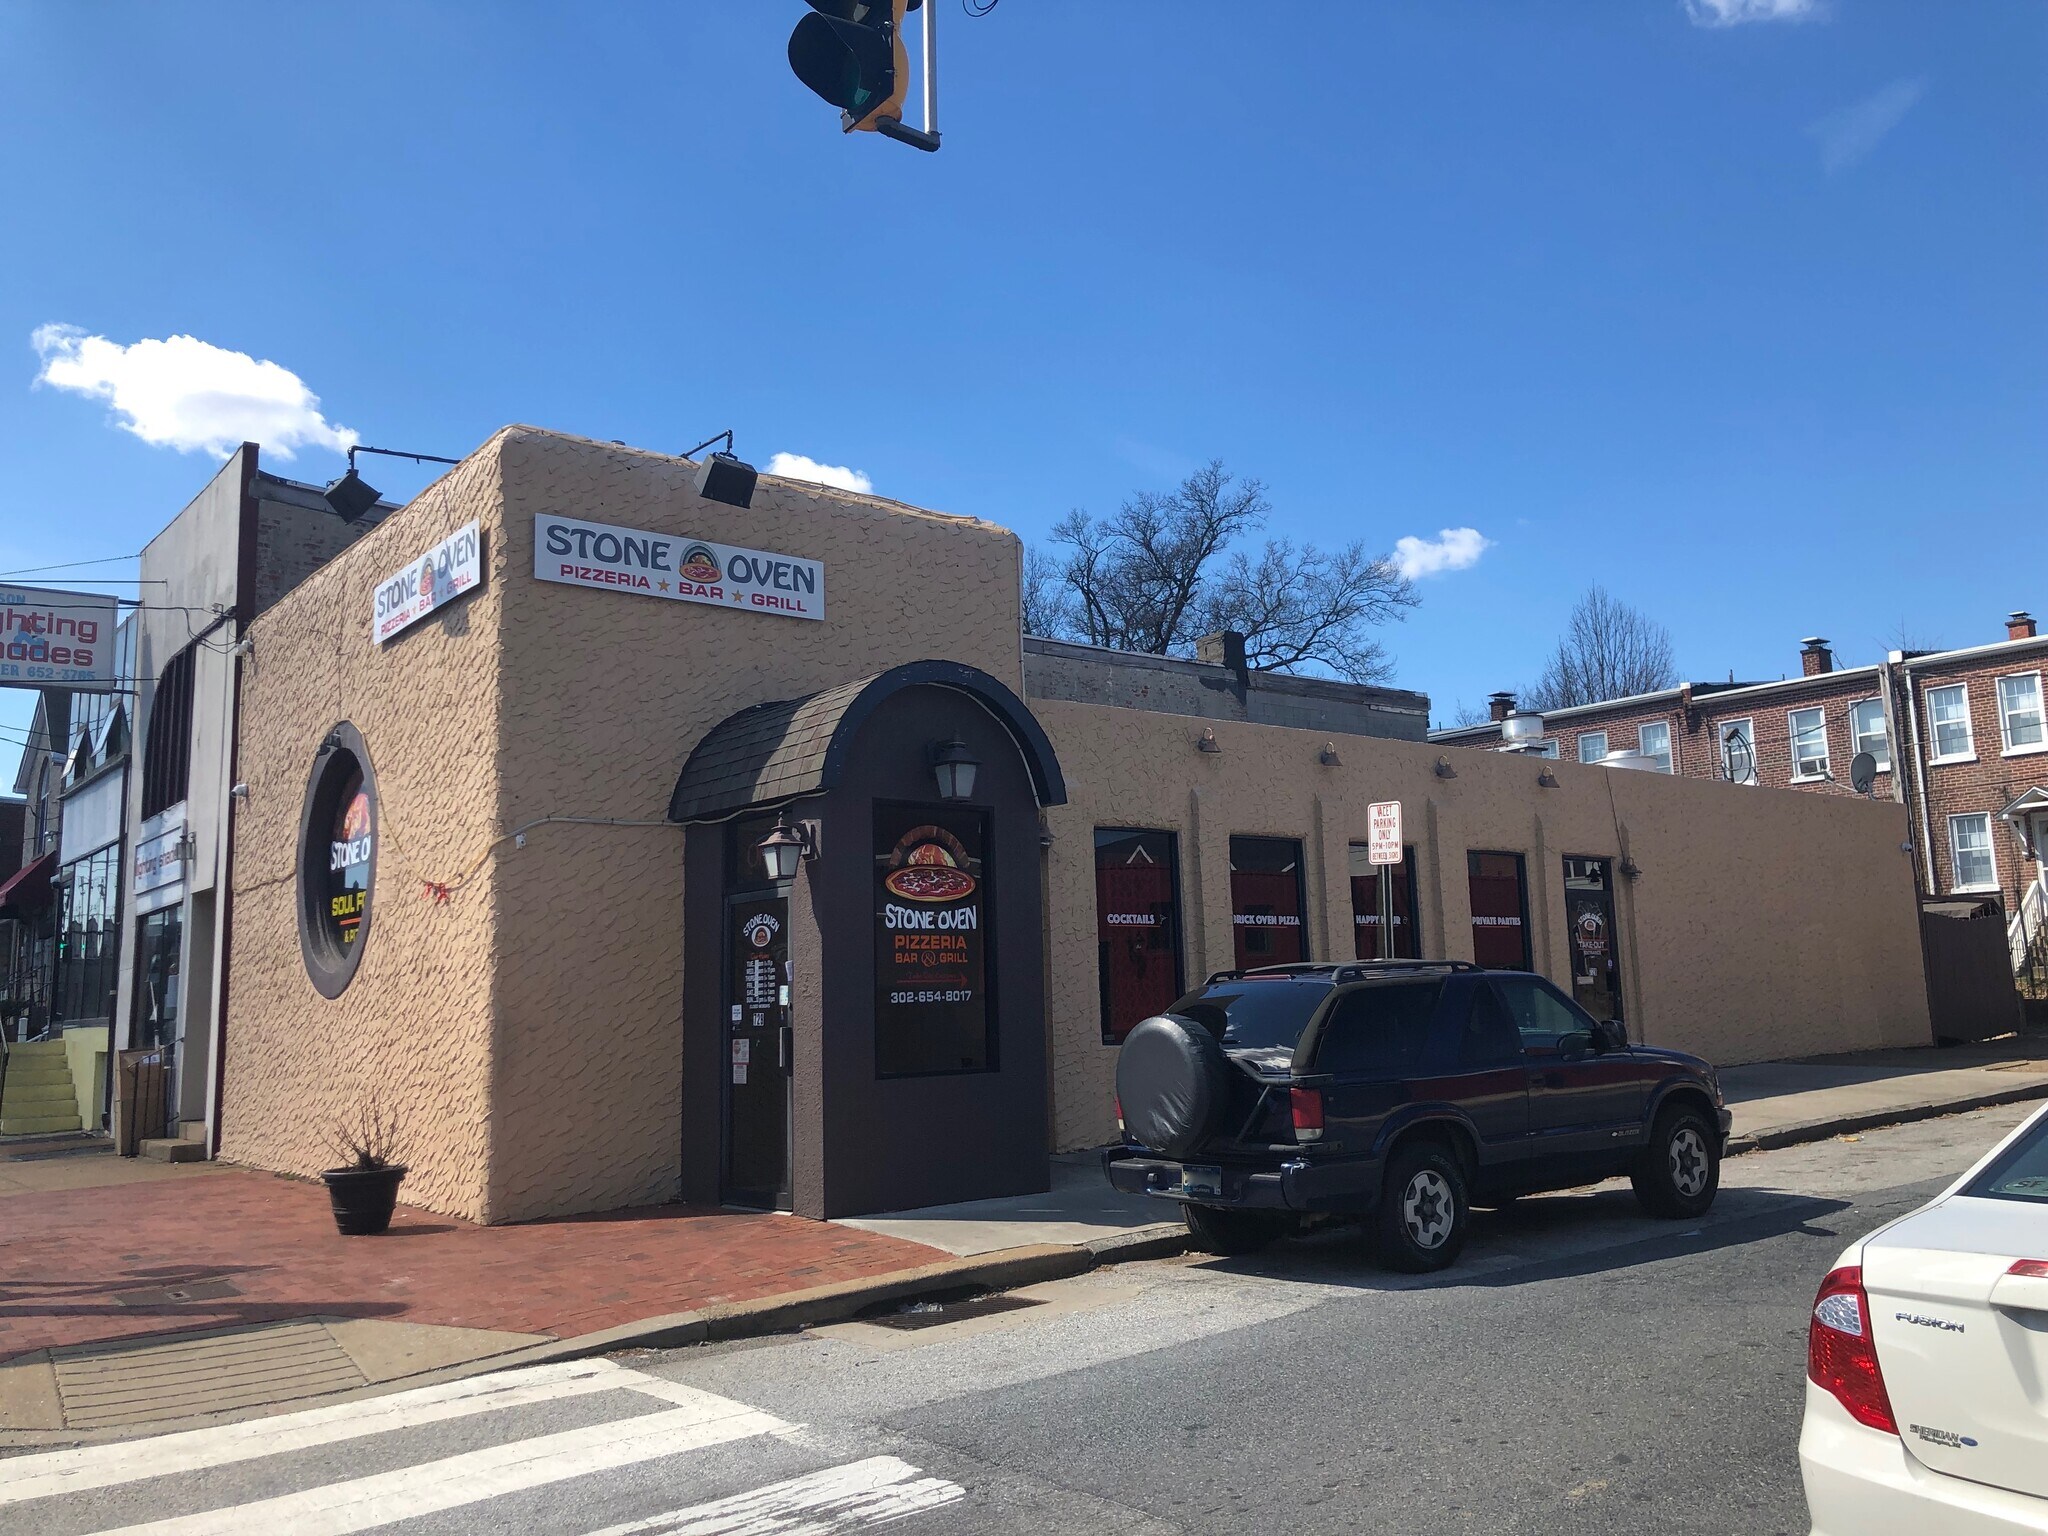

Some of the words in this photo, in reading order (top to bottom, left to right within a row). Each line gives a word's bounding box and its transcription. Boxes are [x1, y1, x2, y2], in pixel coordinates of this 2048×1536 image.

[546, 524, 671, 572] STONE
[727, 554, 815, 594] OVEN
[377, 568, 418, 618] STONE
[437, 529, 476, 579] OVEN
[560, 564, 651, 589] PIZZERIA
[679, 582, 724, 599] BAR
[751, 593, 807, 612] GRILL
[381, 609, 411, 635] PIZZERIA
[419, 592, 437, 611] BAR
[446, 571, 472, 594] GRILL
[0, 608, 98, 644] hting
[0, 641, 94, 667] ades
[1373, 817, 1396, 829] PARKING
[1379, 829, 1391, 840] ONLY
[1372, 841, 1399, 850] 5PM-10PM
[330, 839, 360, 871] STONE
[331, 894, 355, 917] SOUL
[743, 914, 763, 936] STONE
[763, 914, 780, 932] OVEN
[885, 903, 935, 929] STONE
[938, 905, 977, 930] OVEN
[1106, 913, 1155, 924] COCKTAILS
[1256, 915, 1277, 925] OVEN
[1279, 915, 1300, 926] PIZZA
[1356, 915, 1379, 925] HAPPY
[1472, 917, 1496, 926] PRIVATE
[1498, 917, 1521, 926] PARTIES
[894, 935, 967, 949] PIZZERIA
[1579, 941, 1605, 949] TAKE-OUT
[895, 953, 918, 963] BAR
[940, 952, 968, 963] GRILL
[890, 990, 972, 1003] 302-654-8017
[1895, 1312, 1965, 1334] FUSION
[1910, 1424, 1959, 1442] SHERIDAN
